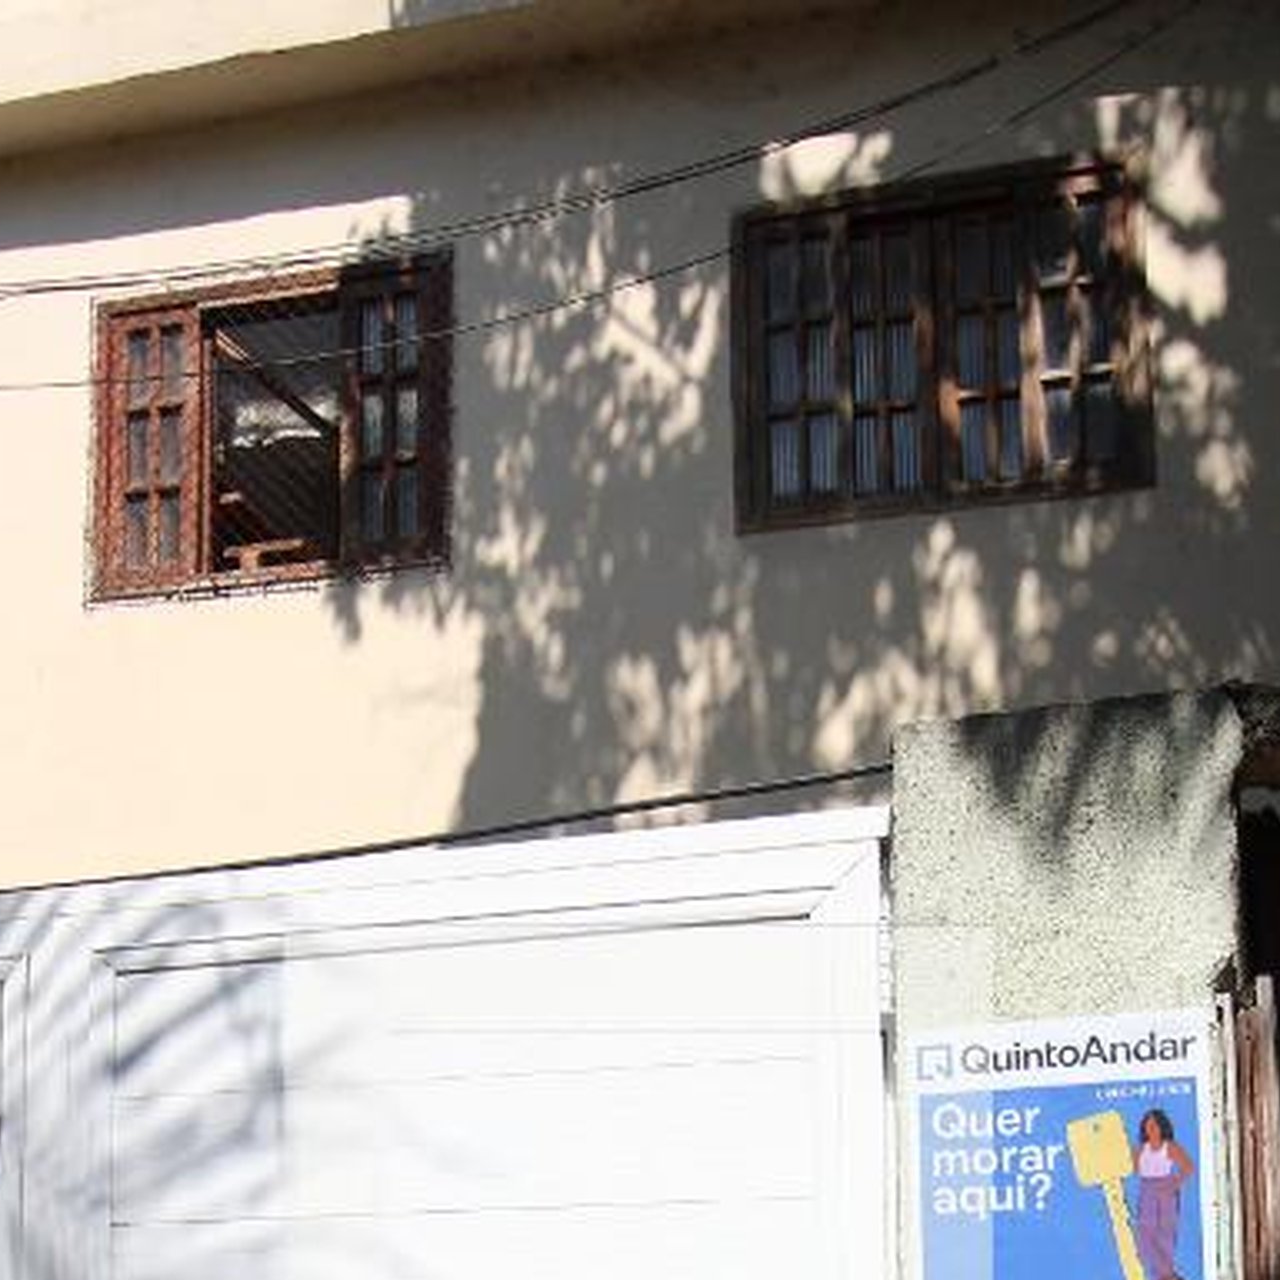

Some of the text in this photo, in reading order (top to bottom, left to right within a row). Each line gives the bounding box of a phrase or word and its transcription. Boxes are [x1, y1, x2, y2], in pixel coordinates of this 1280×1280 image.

[960, 1032, 1196, 1075] QuintoAndar
[932, 1102, 1041, 1139] Quer
[932, 1144, 1065, 1177] morar
[932, 1172, 1052, 1220] aqui?
